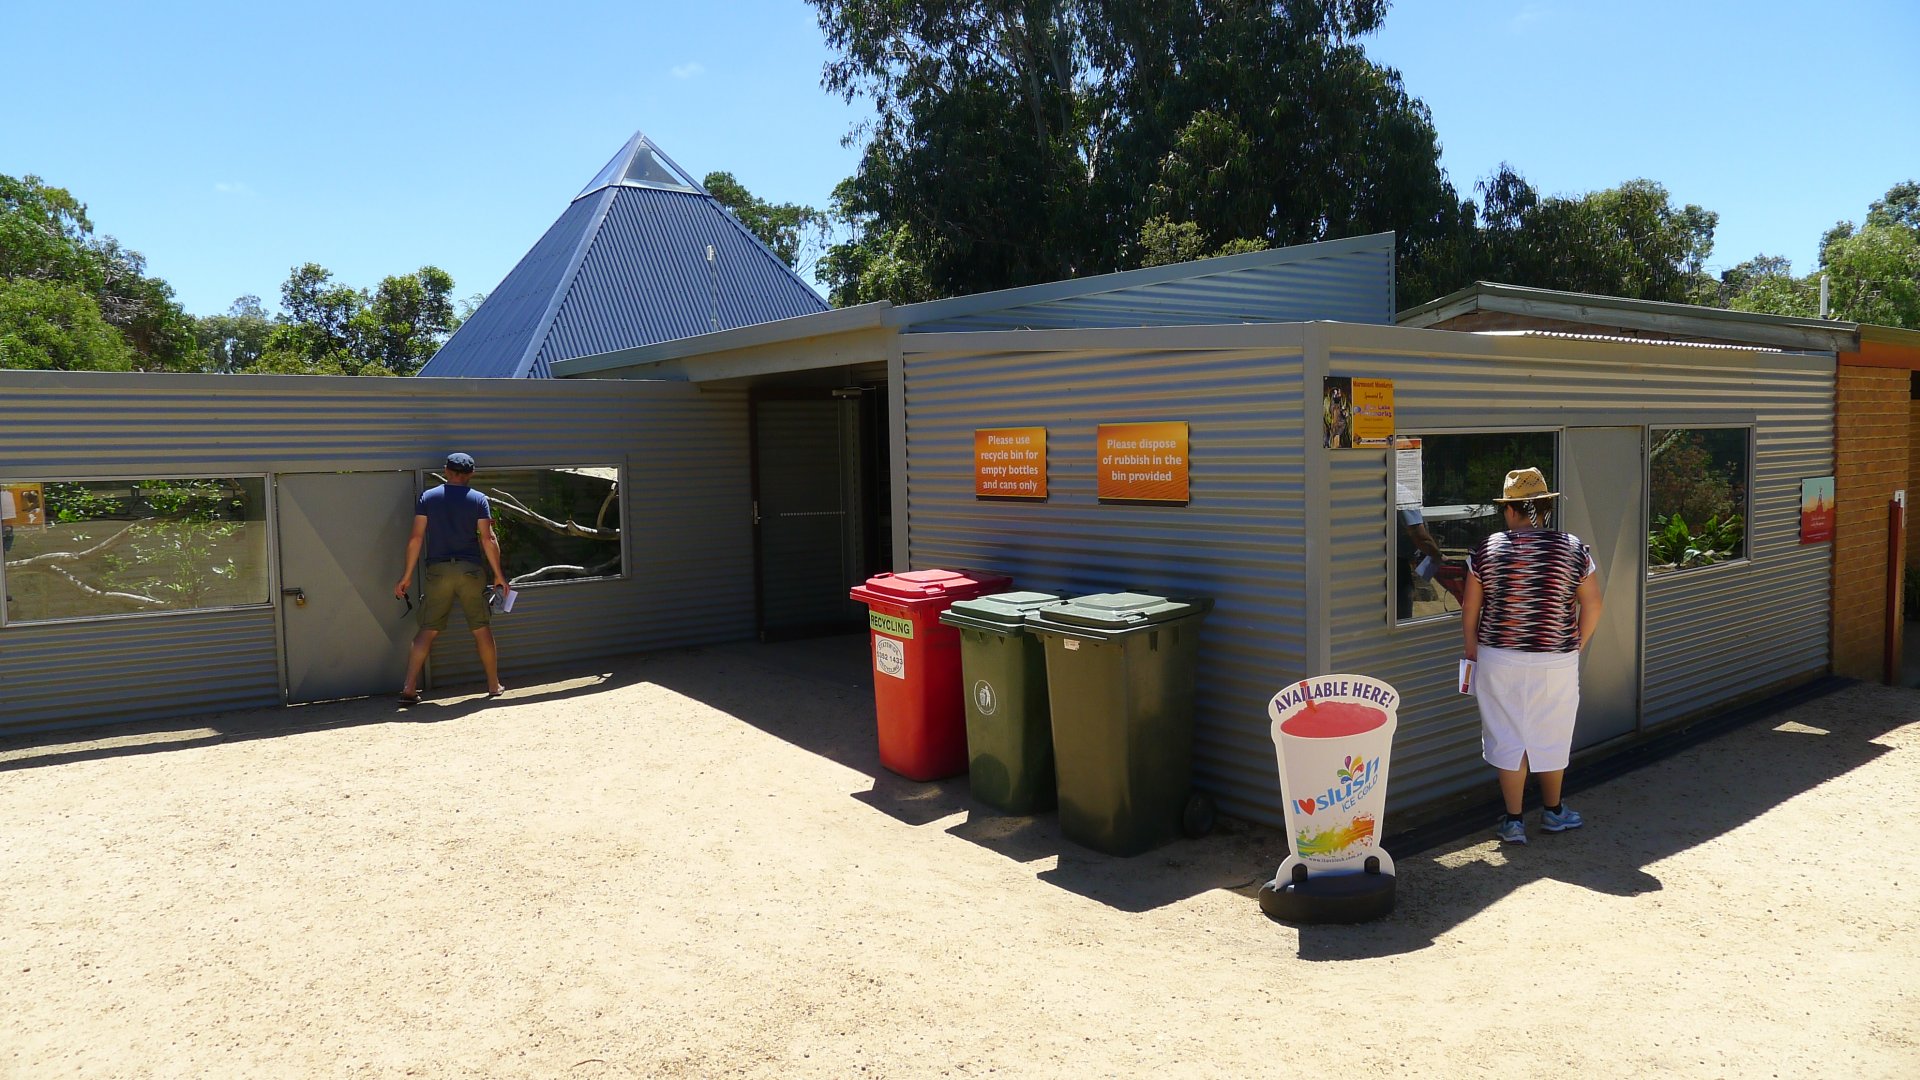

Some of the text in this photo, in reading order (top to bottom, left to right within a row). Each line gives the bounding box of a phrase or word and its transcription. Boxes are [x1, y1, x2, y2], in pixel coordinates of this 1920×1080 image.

[988, 435, 1030, 445] Please use
[1107, 438, 1177, 451] Please dispose
[981, 449, 1039, 462] recycle bin for
[1102, 454, 1182, 465] of rubbish in the
[981, 464, 1039, 477] empty bottles
[1111, 470, 1172, 483] bin provided
[983, 479, 1038, 492] and cans only
[870, 614, 910, 634] RECYCLING
[889, 656, 904, 665] 1433
[1274, 682, 1395, 714] AVAILABLE HERE!
[1317, 756, 1380, 811] slush
[1342, 774, 1378, 813] ICE COLD
